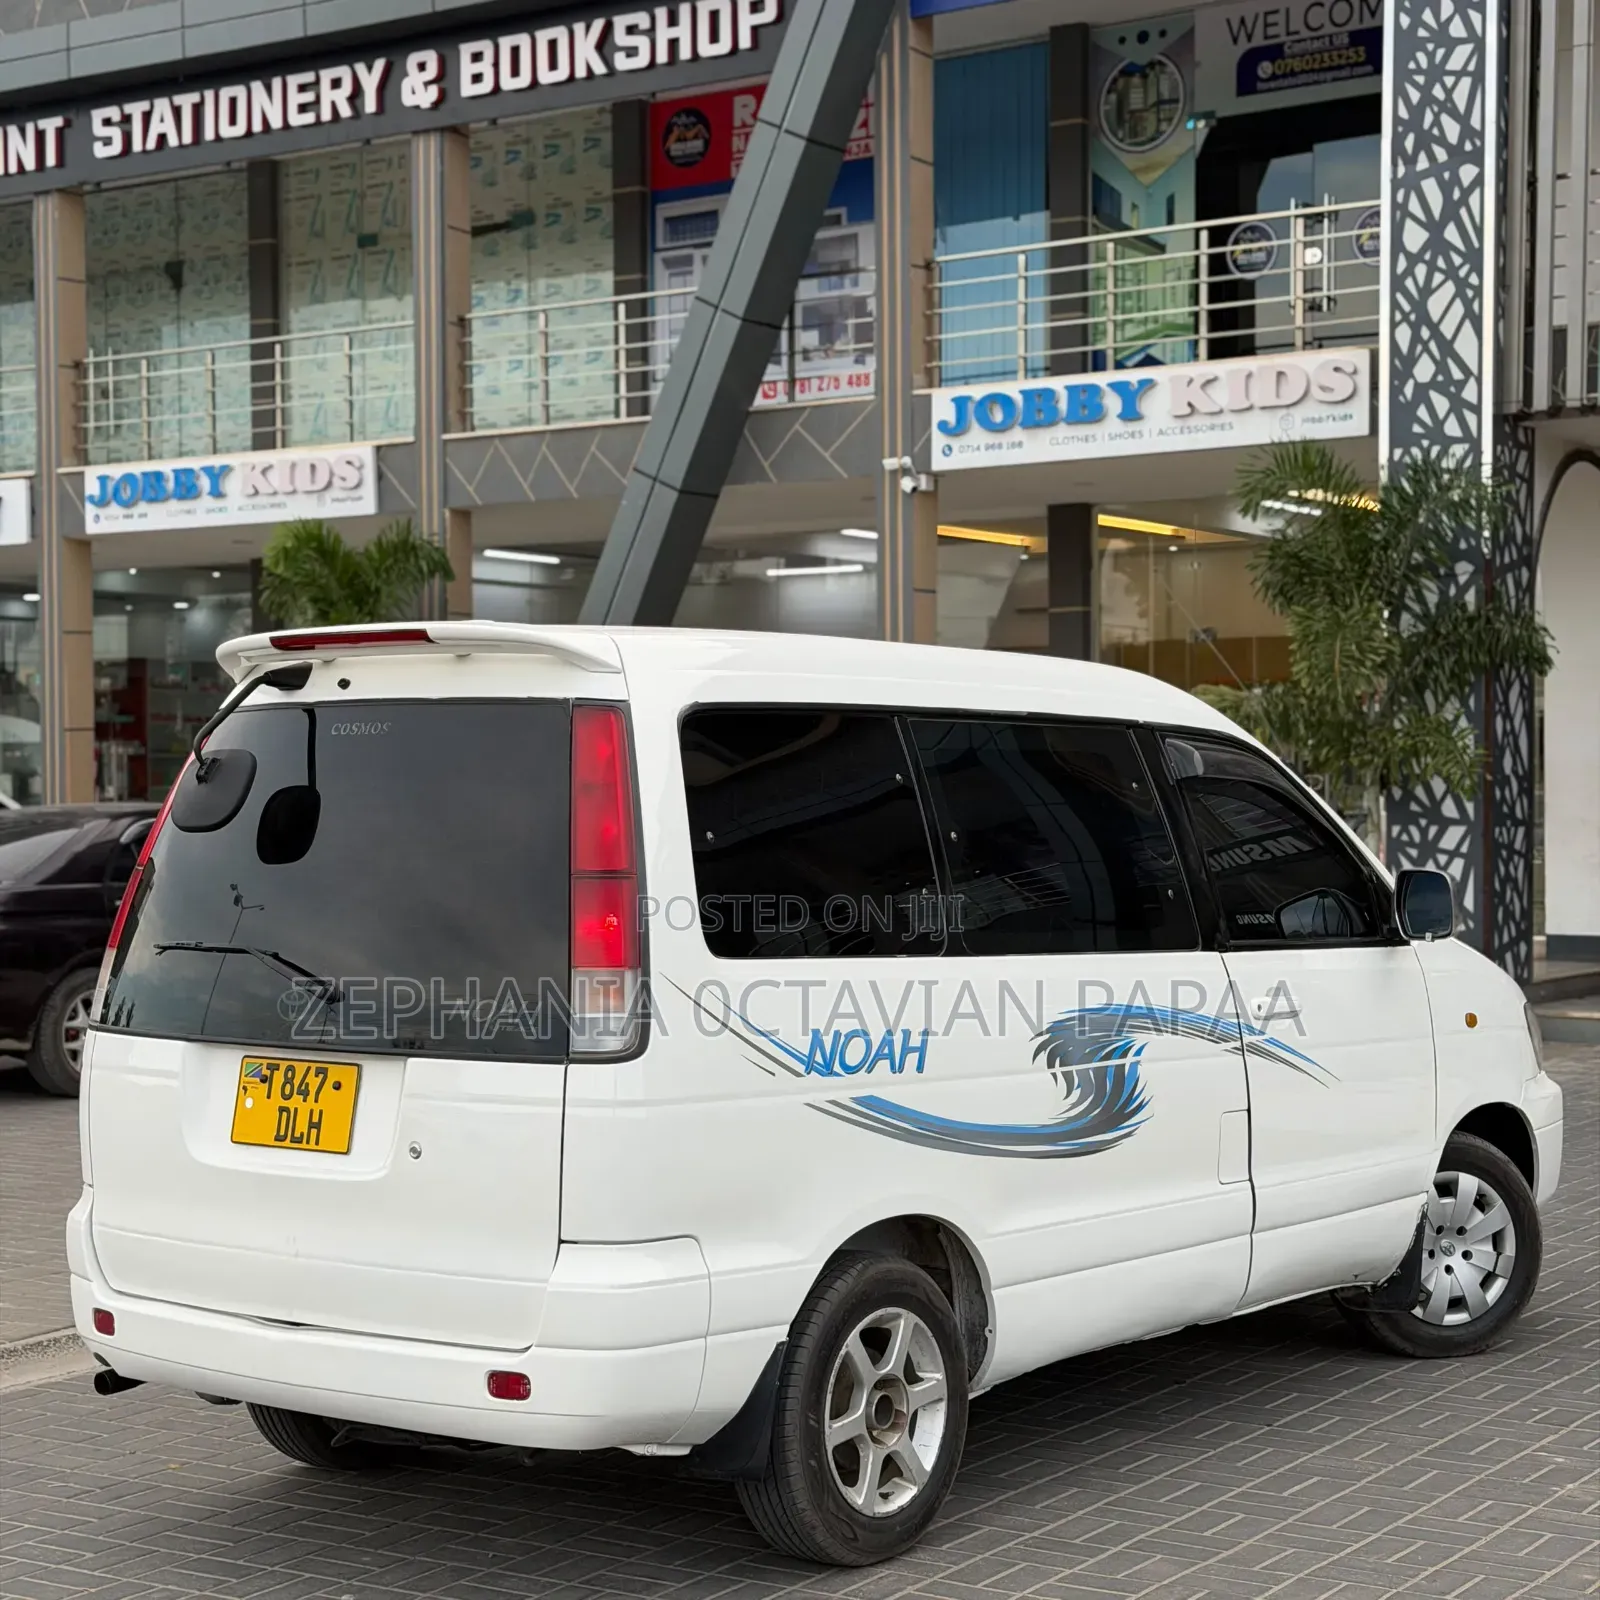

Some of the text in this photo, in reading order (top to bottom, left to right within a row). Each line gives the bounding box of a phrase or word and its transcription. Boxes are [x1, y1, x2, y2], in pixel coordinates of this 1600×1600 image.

[91, 58, 390, 159] STATIONERY
[401, 49, 441, 109] &
[459, 0, 780, 98] BOOKSHOP
[937, 359, 1358, 437] JOBBY KIDS
[1049, 422, 1234, 446] CLOTHES SHOES ACCESSORIES
[86, 454, 365, 509] JOBBY KIDS
[331, 722, 392, 735] COSMOS
[804, 1028, 929, 1075] NOAH
[265, 1063, 329, 1103] T847
[274, 1105, 324, 1146] DLH
